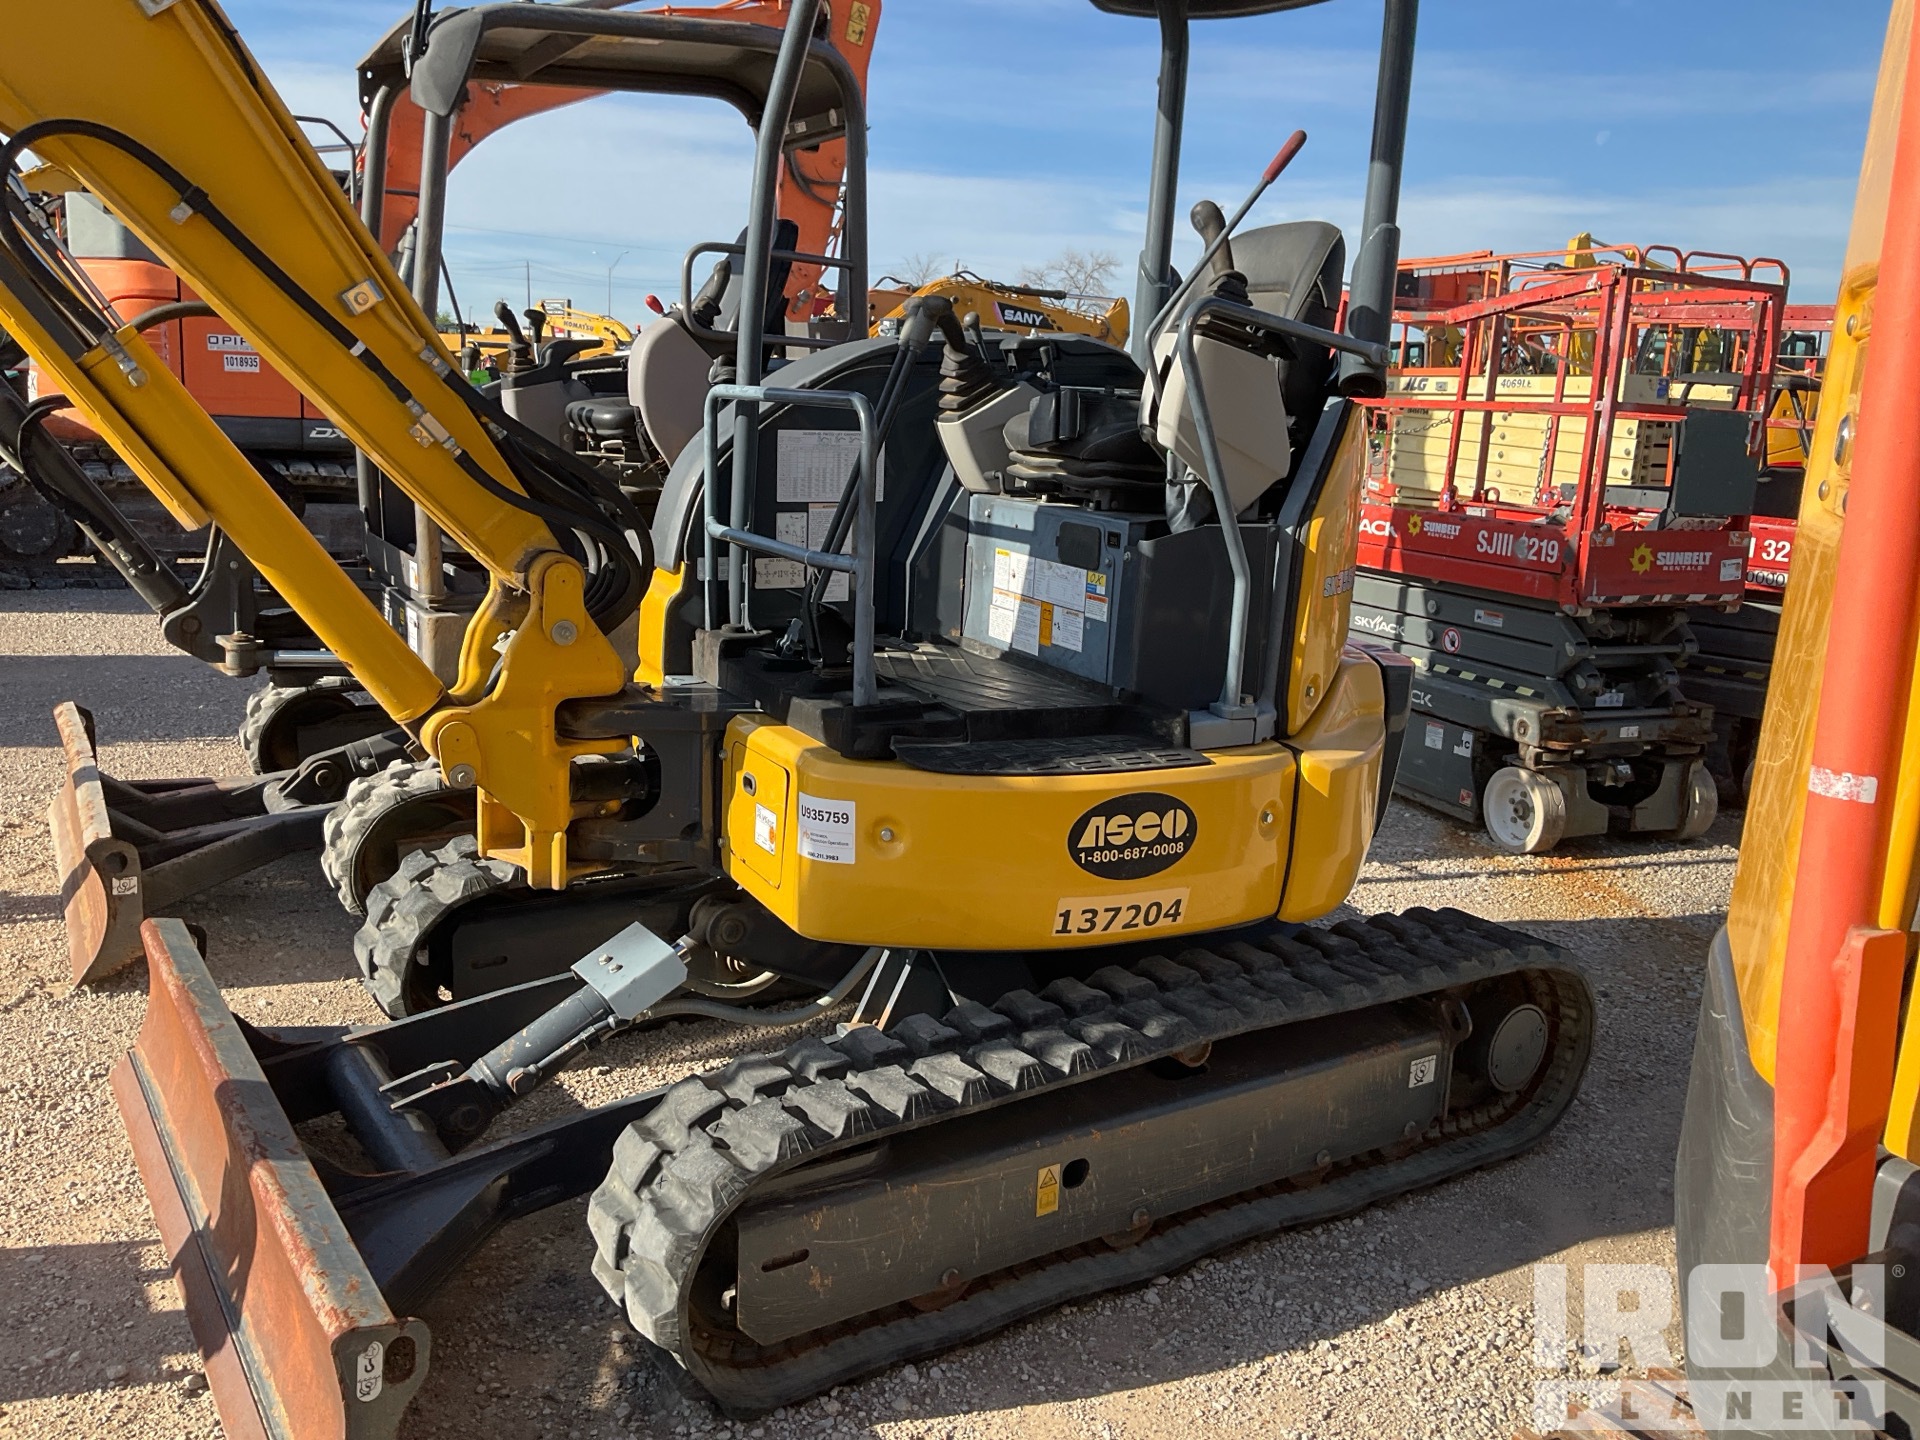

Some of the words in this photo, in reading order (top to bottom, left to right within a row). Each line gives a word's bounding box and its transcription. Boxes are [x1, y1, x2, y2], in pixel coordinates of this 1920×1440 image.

[563, 320, 594, 332] KOMATSU
[1004, 309, 1043, 326] SANY
[225, 356, 258, 368] 1018935
[1358, 509, 1398, 538] ACK
[1423, 521, 1461, 536] SUNBELT
[1656, 551, 1713, 566] SUNBELT
[1354, 614, 1406, 636] SKYJACK
[801, 804, 850, 825] U935759
[1077, 808, 1189, 848] ASCO
[1078, 842, 1184, 864] 1-800-687-0008
[1054, 898, 1183, 935] 137204
